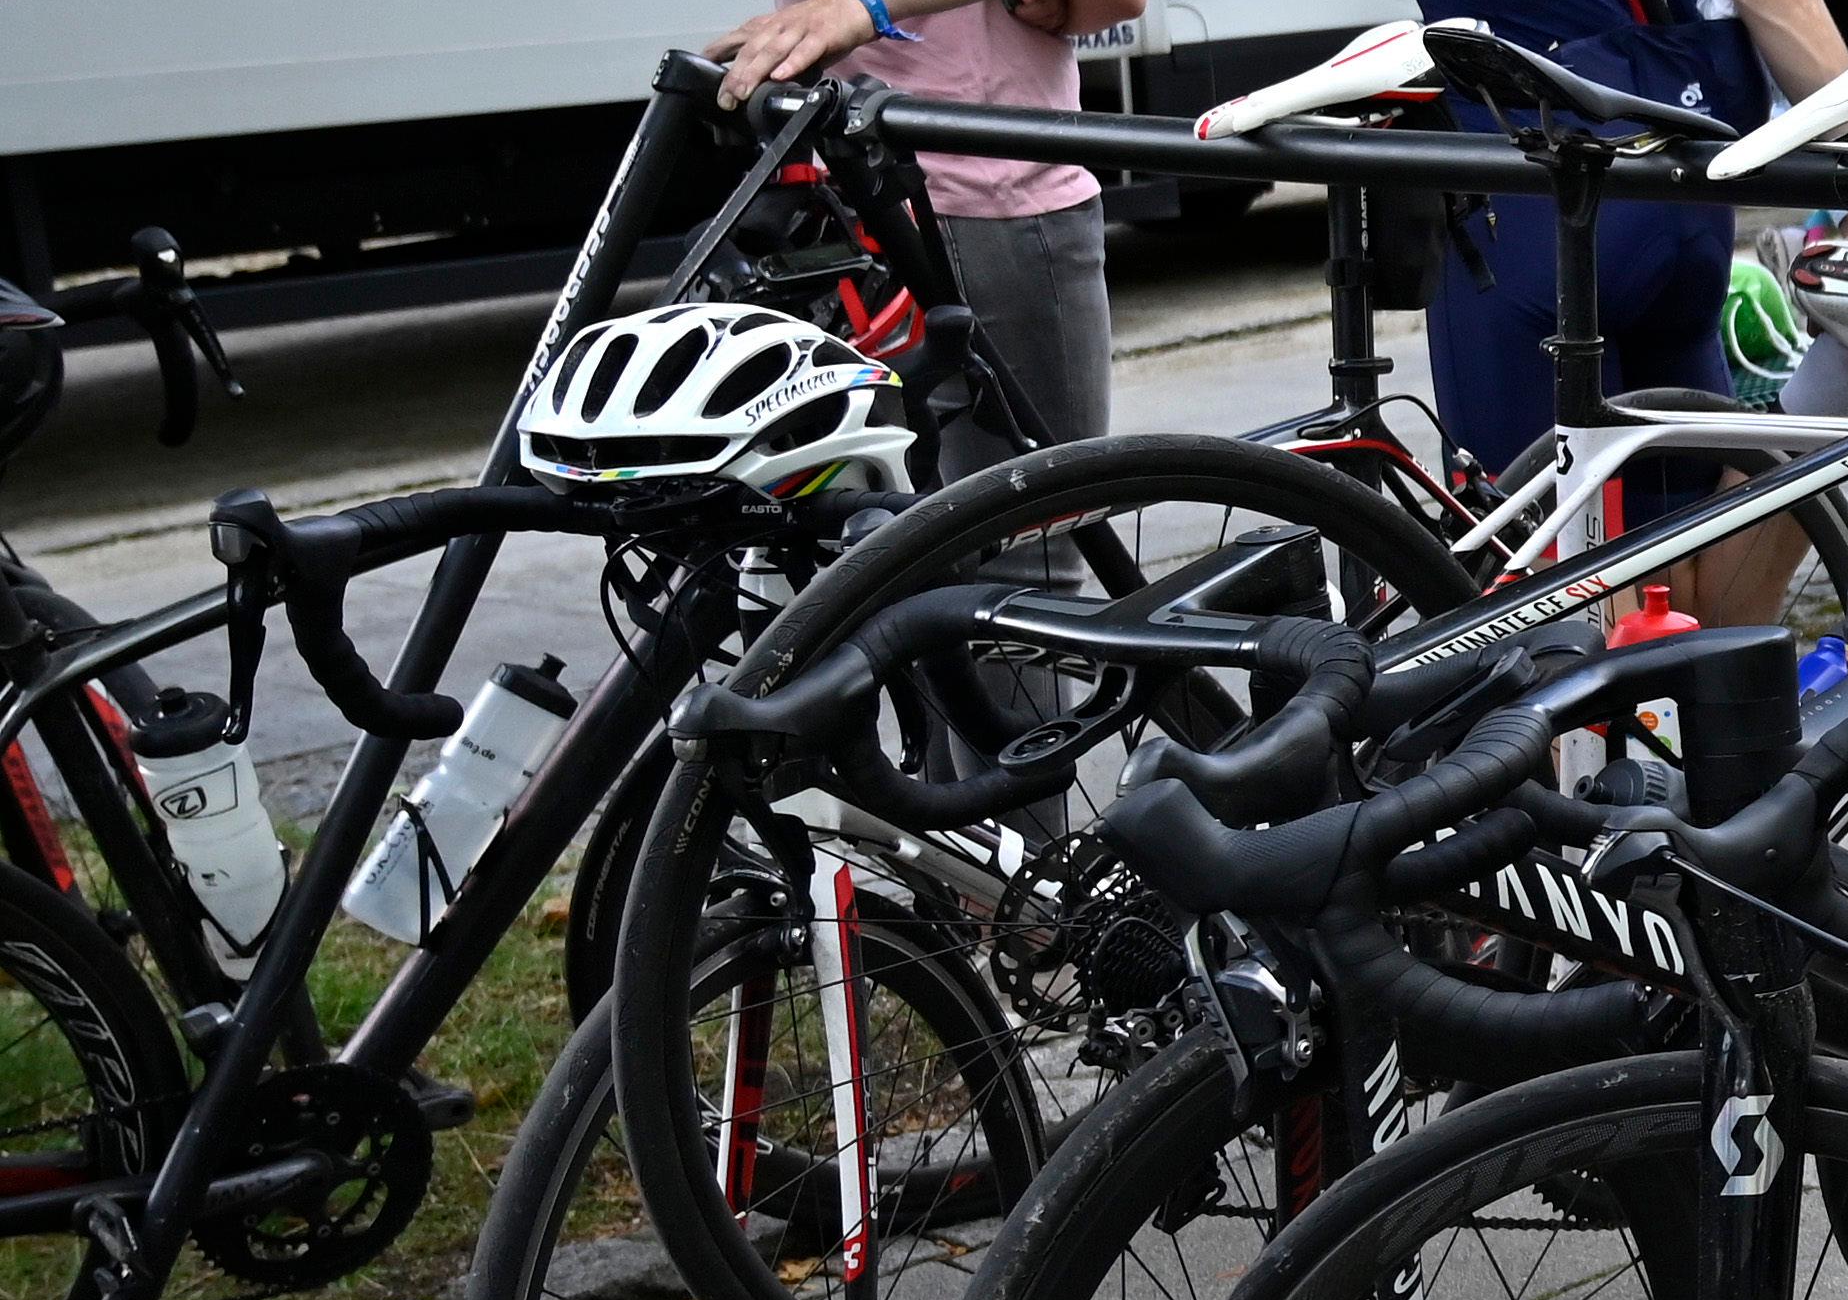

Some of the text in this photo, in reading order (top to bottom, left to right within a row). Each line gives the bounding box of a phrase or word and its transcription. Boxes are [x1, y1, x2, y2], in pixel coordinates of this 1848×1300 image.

[1068, 24, 1135, 50] AXAS
[744, 370, 839, 428] SPECIALIZED
[1414, 607, 1539, 667] ULTIMATE
[1565, 575, 1614, 603] SLX
